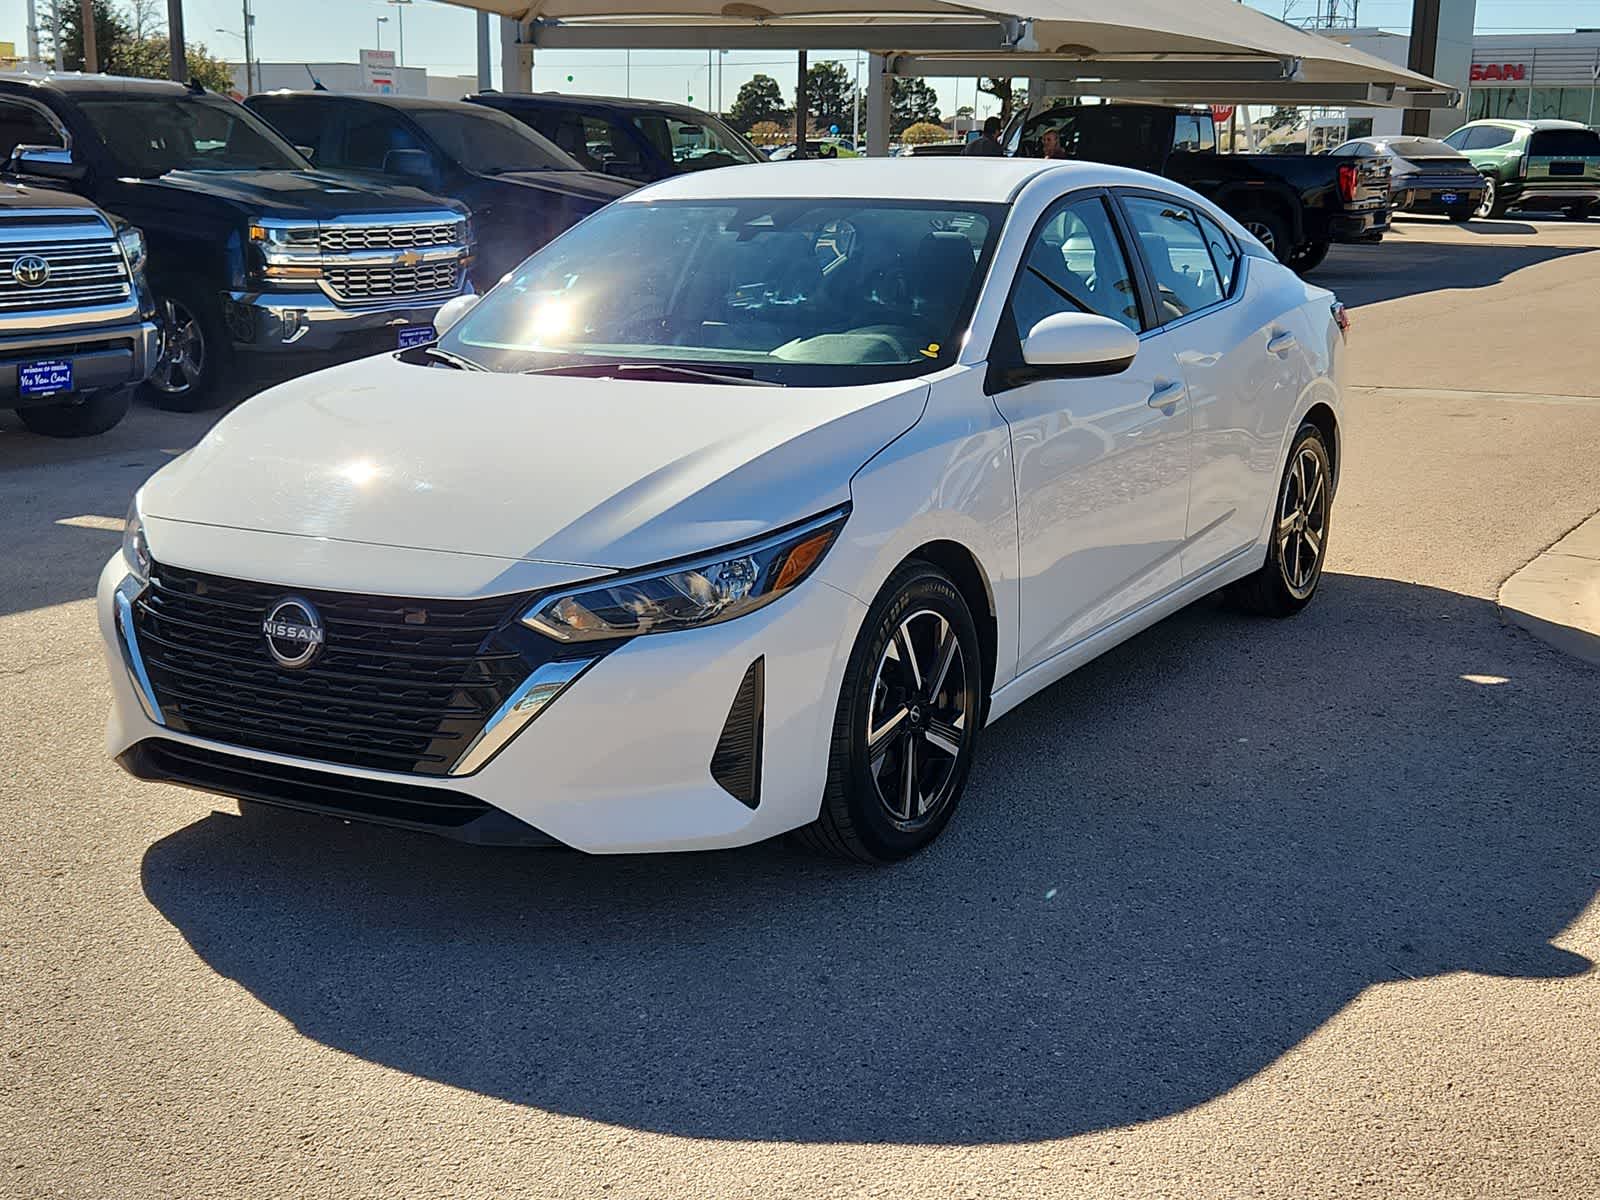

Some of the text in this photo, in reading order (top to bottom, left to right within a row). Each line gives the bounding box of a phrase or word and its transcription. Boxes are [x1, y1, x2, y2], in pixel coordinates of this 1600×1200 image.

[21, 370, 70, 386] Yes You Can!
[263, 622, 322, 641] NISSAN
